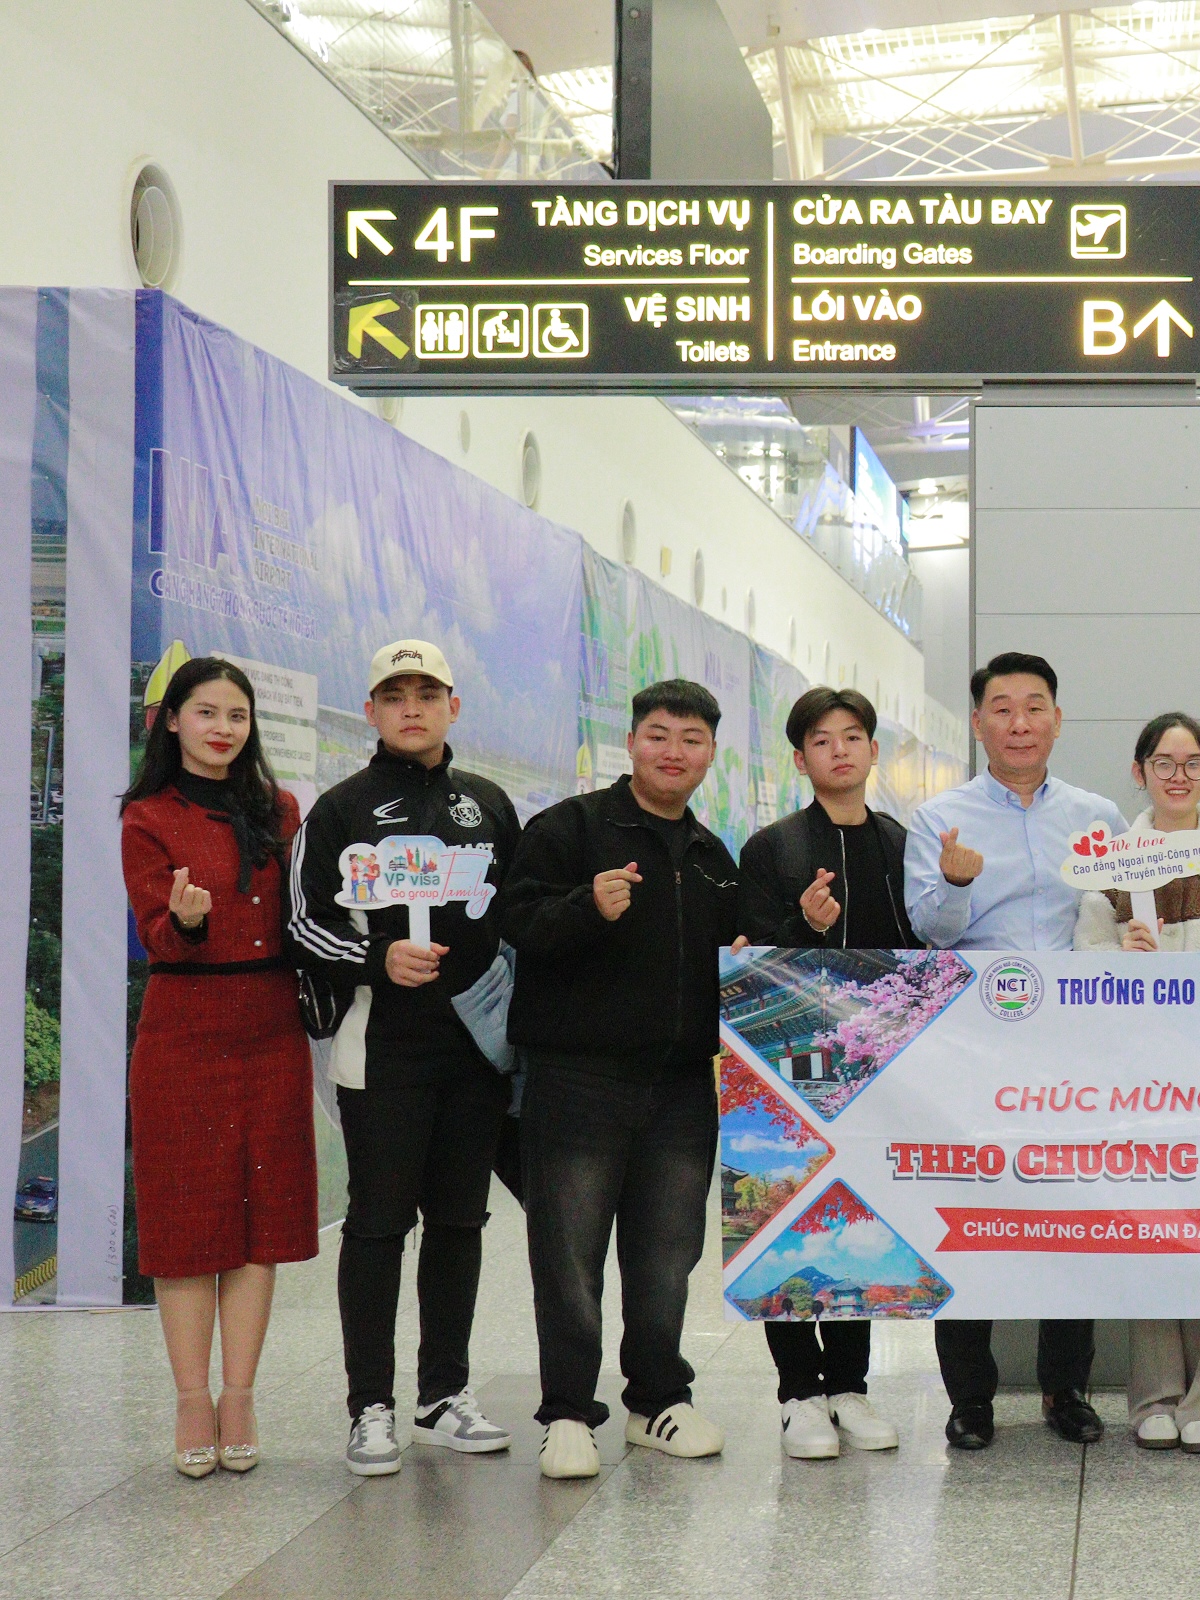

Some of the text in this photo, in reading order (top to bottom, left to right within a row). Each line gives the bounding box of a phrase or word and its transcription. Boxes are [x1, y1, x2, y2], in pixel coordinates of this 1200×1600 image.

[531, 195, 750, 232] TẦNG DỊCH VỤ
[793, 193, 1053, 225] CỬA RA TÀU BAY
[414, 206, 499, 263] 4F
[584, 244, 750, 266] Services Floor
[793, 243, 973, 269] Boarding Gates
[624, 293, 750, 328] VỆ SINH
[852, 289, 922, 321] VÀO
[1082, 300, 1127, 356] B
[676, 340, 750, 362] Toilets
[793, 340, 896, 361] Entrance
[149, 448, 240, 579] NIA
[253, 525, 319, 572] INTERNATIONAL
[254, 557, 292, 592] AIRPORT
[1109, 836, 1166, 853] We love
[384, 873, 440, 886] VP visa
[1073, 865, 1090, 875] Cao
[1118, 855, 1144, 868] Ngoại
[1112, 872, 1122, 883] và
[1158, 864, 1183, 876] thông
[390, 889, 439, 900] Go group
[440, 851, 491, 916] Family
[997, 978, 1027, 992] NCT
[1057, 971, 1145, 1005] TRƯỜNG
[1153, 978, 1195, 1005] CAO
[1000, 1009, 1024, 1018] COLLEGE
[994, 1080, 1100, 1112] CHÚC
[886, 1142, 1006, 1181] THEO
[1013, 1139, 1199, 1182] CHƯƠNG
[963, 1218, 1019, 1238] CHÚC
[1023, 1219, 1086, 1239] MỪNG
[1090, 1218, 1135, 1239] CÁC
[1138, 1223, 1179, 1243] BẠN
